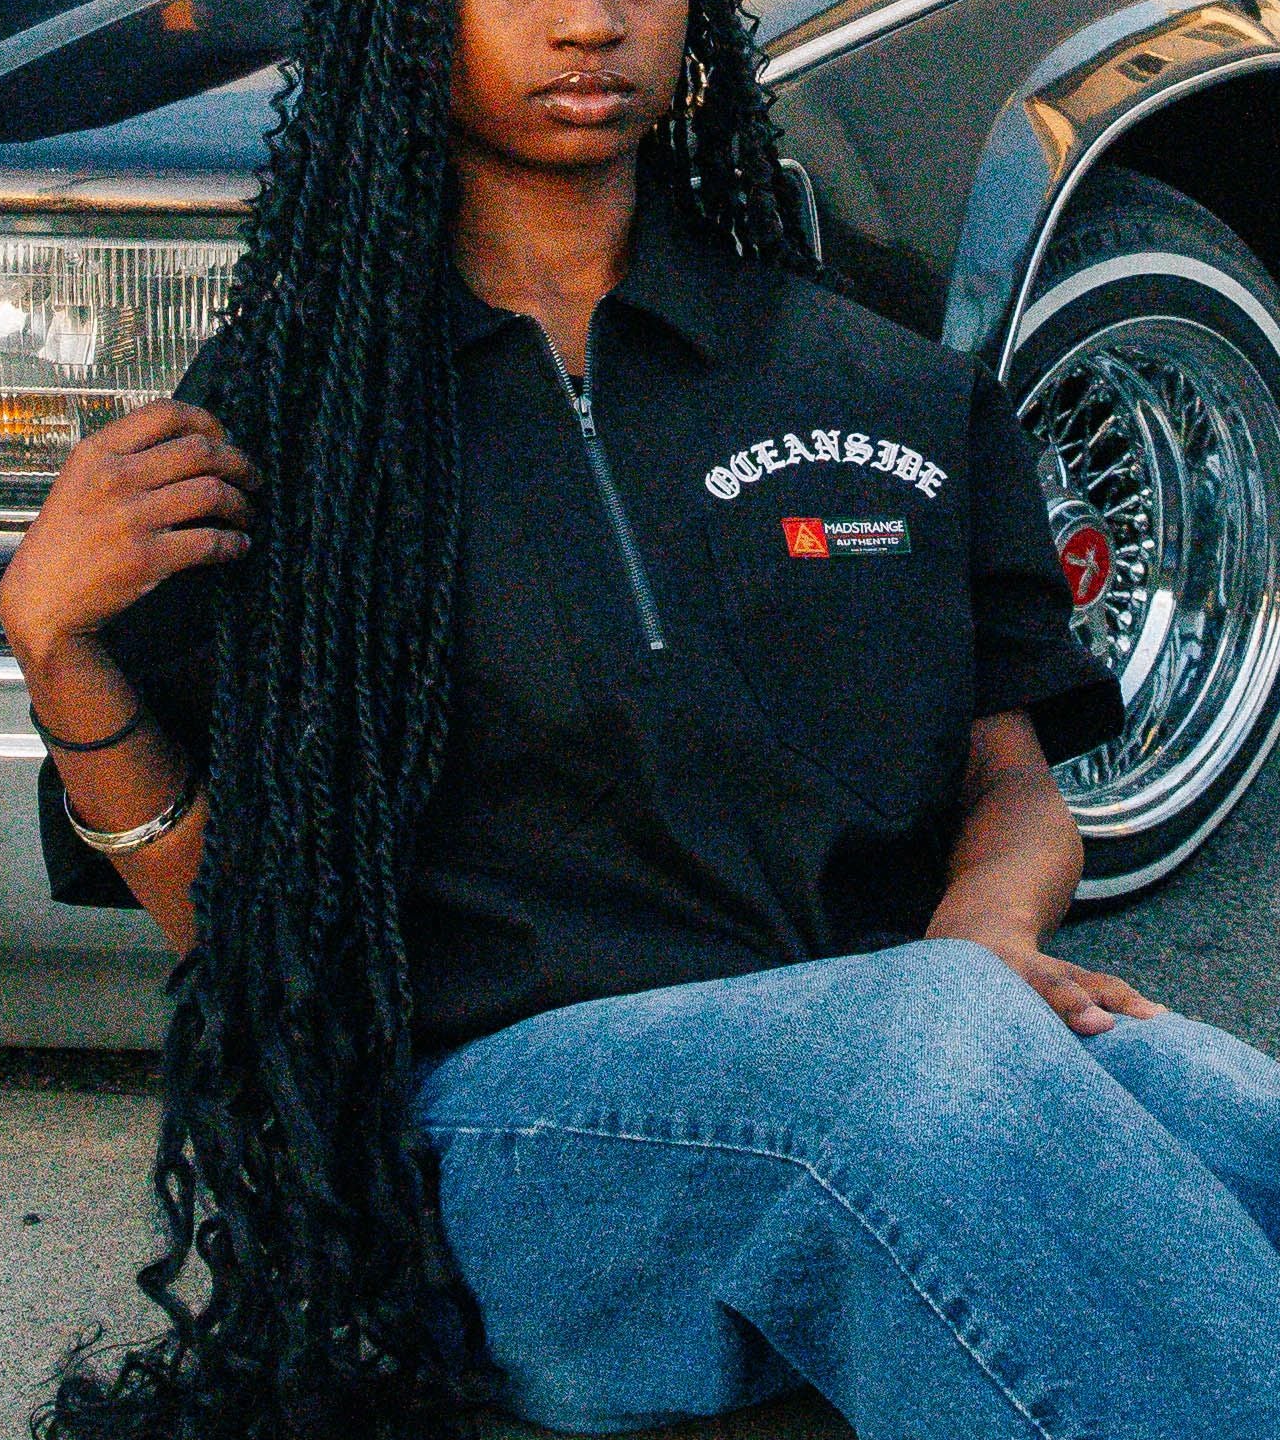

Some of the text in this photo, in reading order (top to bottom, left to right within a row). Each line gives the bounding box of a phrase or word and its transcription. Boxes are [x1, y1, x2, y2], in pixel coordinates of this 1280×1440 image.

[704, 429, 948, 500] OCEANSIDE
[823, 520, 905, 535] MADSTRANGE
[836, 537, 900, 546] AUTHENTIC
